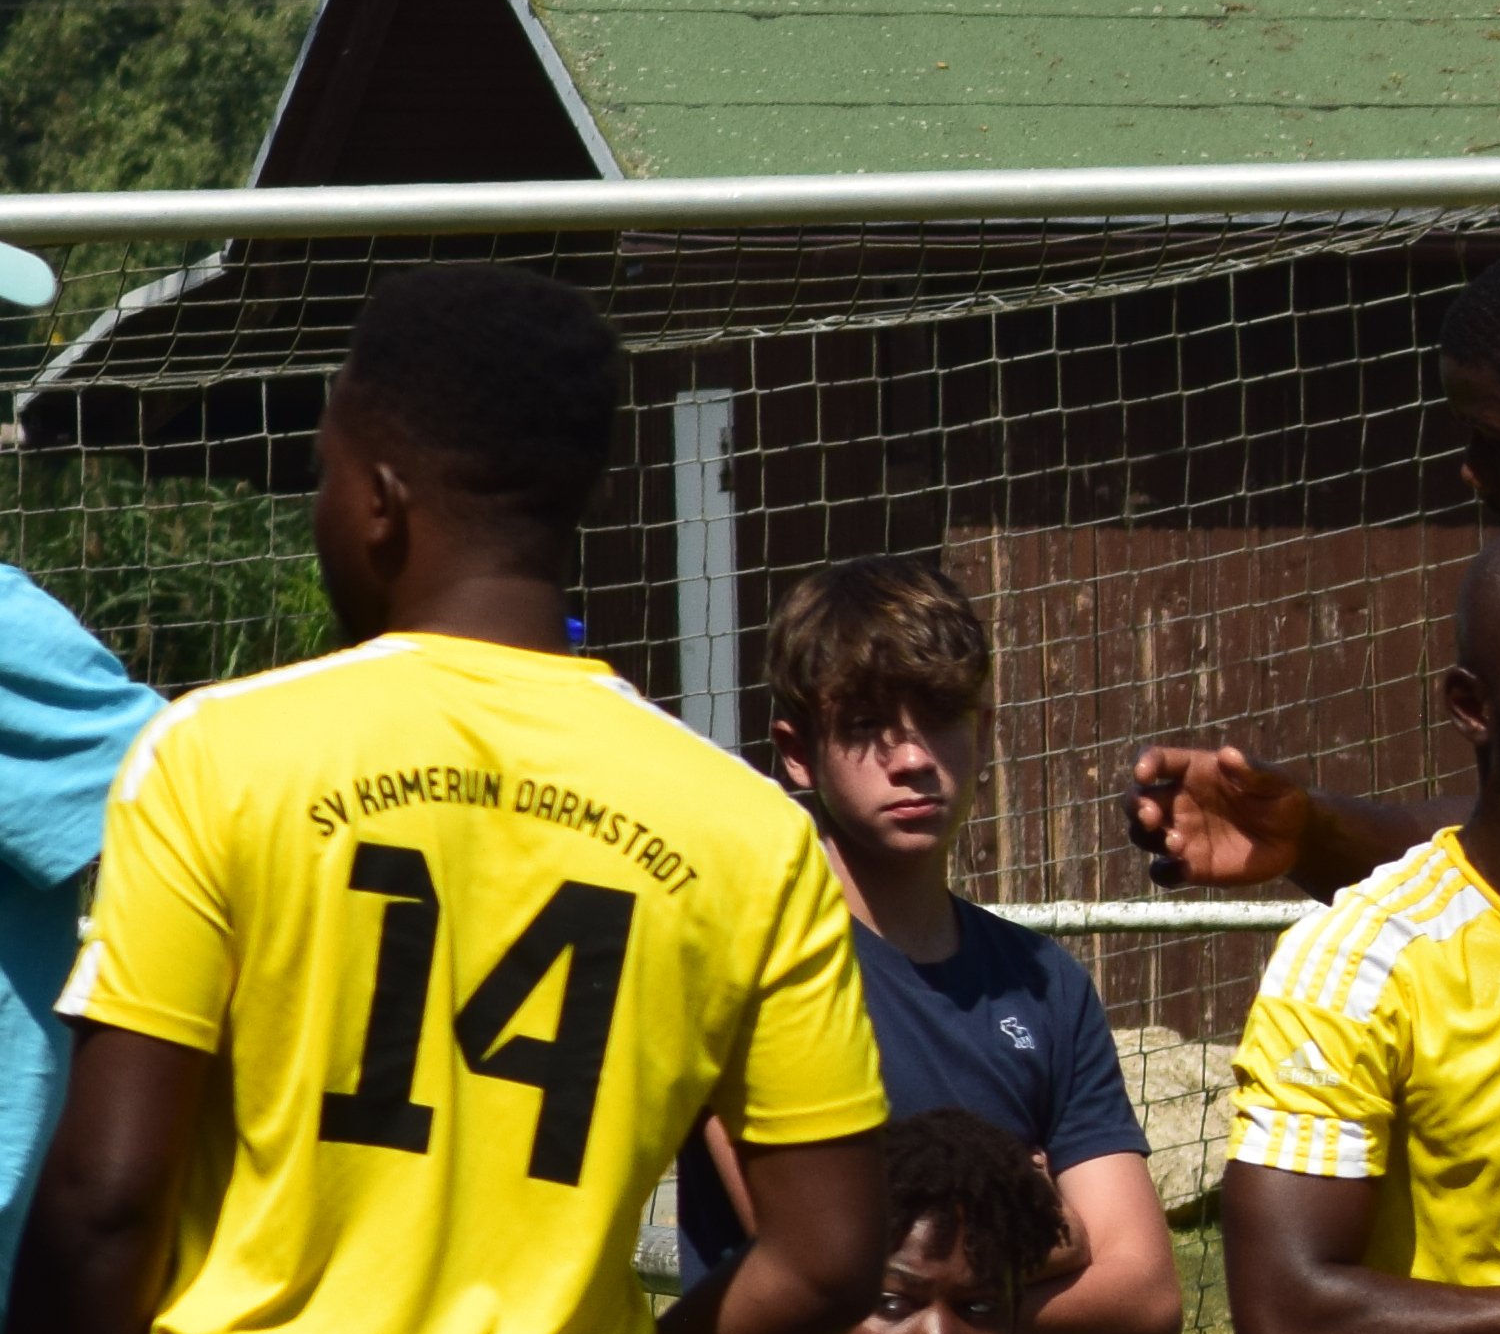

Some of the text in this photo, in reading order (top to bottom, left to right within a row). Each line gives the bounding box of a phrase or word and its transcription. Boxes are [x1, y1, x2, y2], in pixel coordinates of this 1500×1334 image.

[310, 766, 698, 895] SV KAMERUN DARMSTADT
[318, 841, 637, 1187] 14
